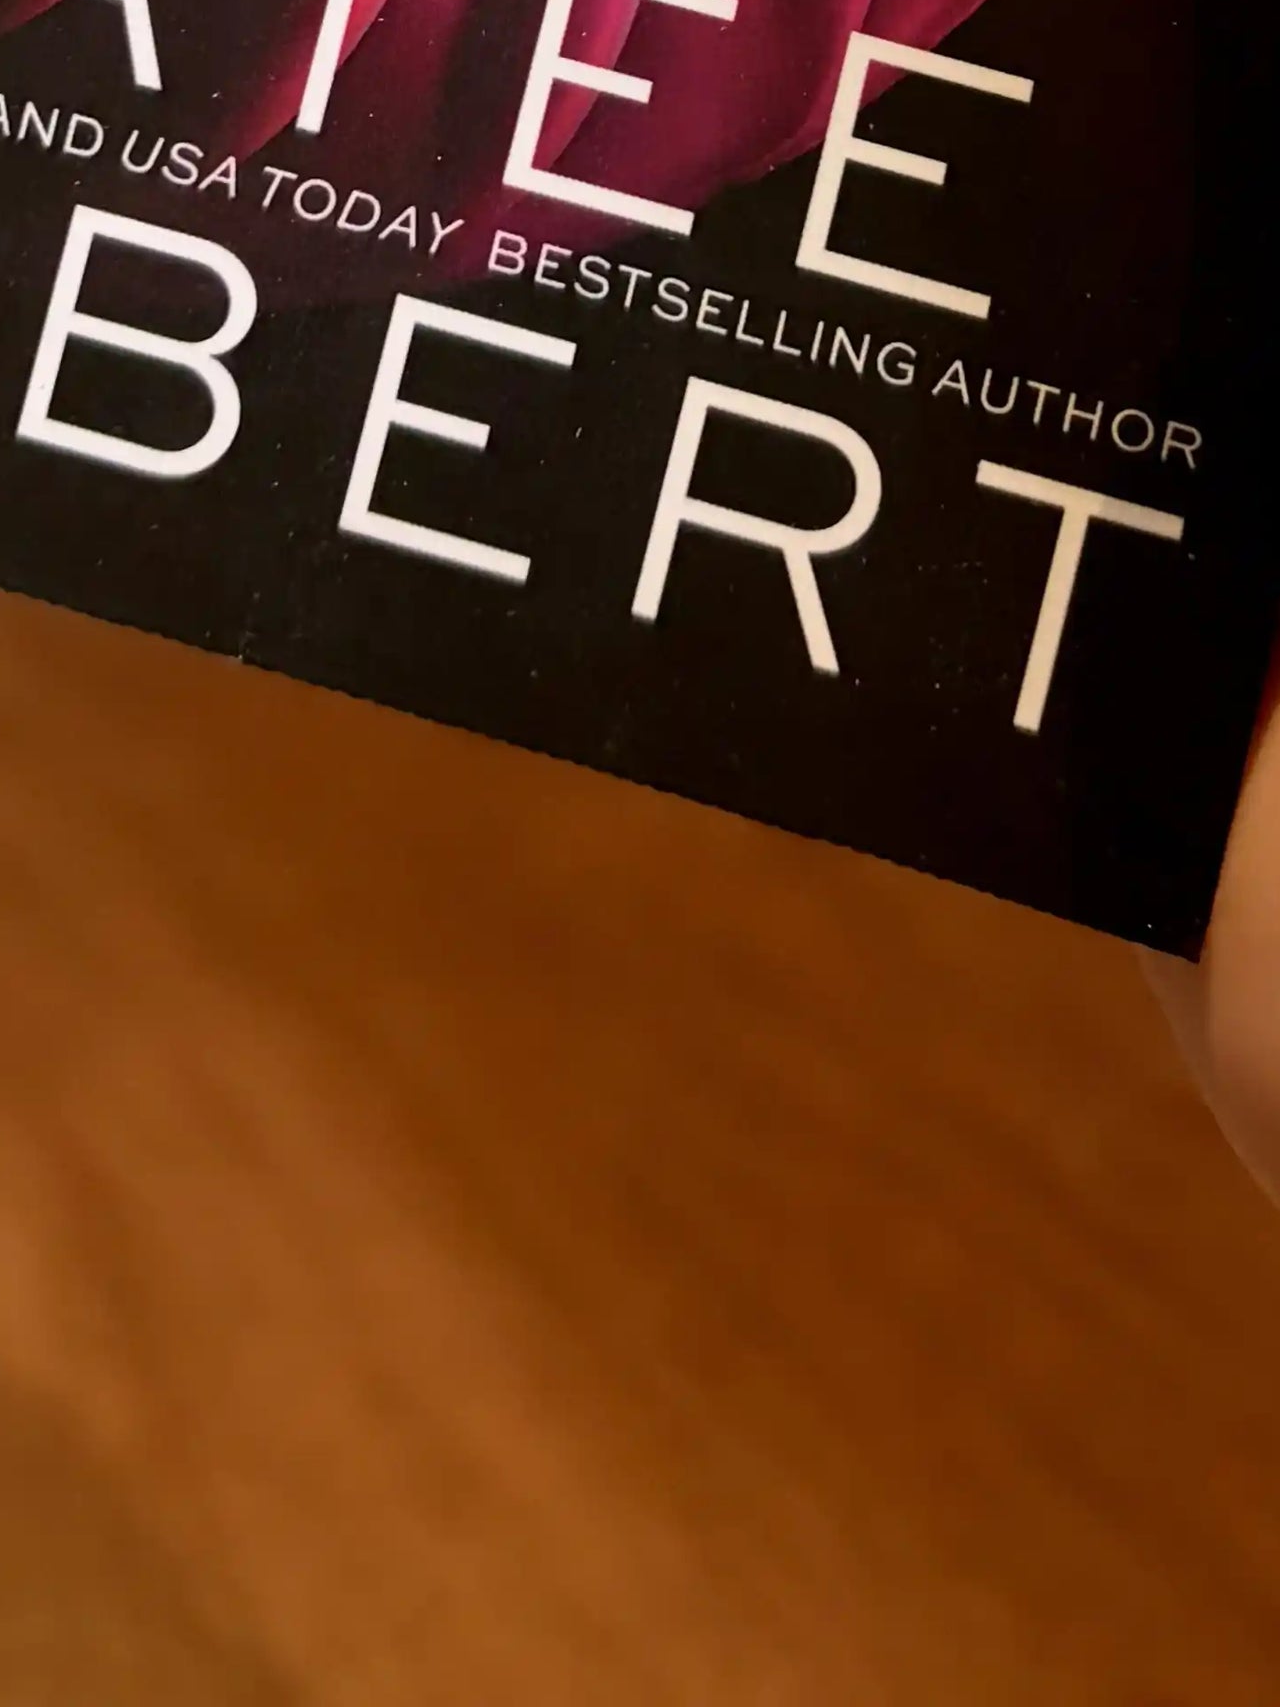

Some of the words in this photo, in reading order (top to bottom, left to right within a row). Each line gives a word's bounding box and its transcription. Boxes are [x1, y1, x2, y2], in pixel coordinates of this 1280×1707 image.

[121, 132, 240, 200] USA
[260, 165, 465, 257] TODAY
[486, 229, 918, 388] BESTSELLING
[931, 358, 1205, 472] AUTHOR
